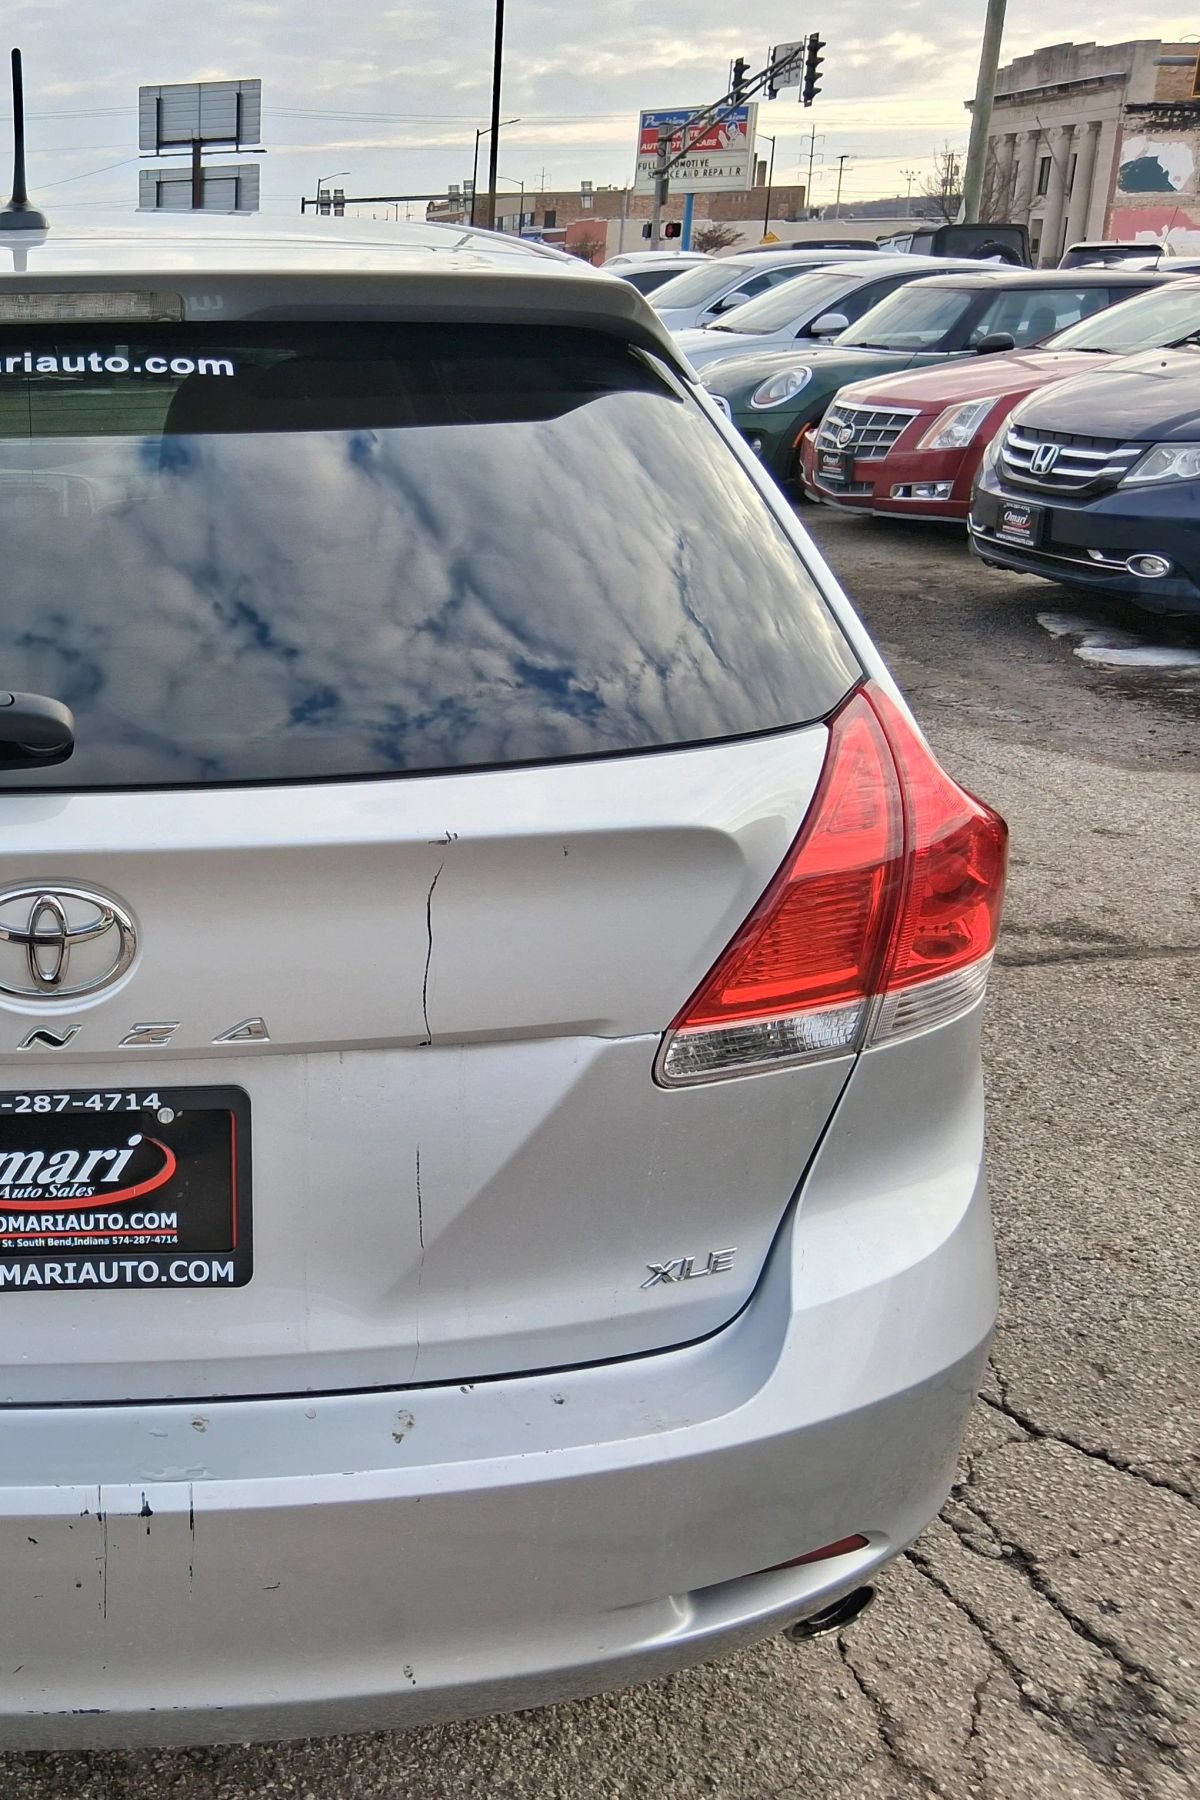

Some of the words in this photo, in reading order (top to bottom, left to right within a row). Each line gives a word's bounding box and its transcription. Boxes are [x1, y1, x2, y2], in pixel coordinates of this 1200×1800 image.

[1004, 510, 1029, 525] Omari
[45, 1183, 96, 1198] Sales
[2, 1239, 15, 1248] St.
[17, 1238, 45, 1248] South
[112, 1235, 178, 1245] 574-287-4714
[640, 1247, 738, 1288] XLE
